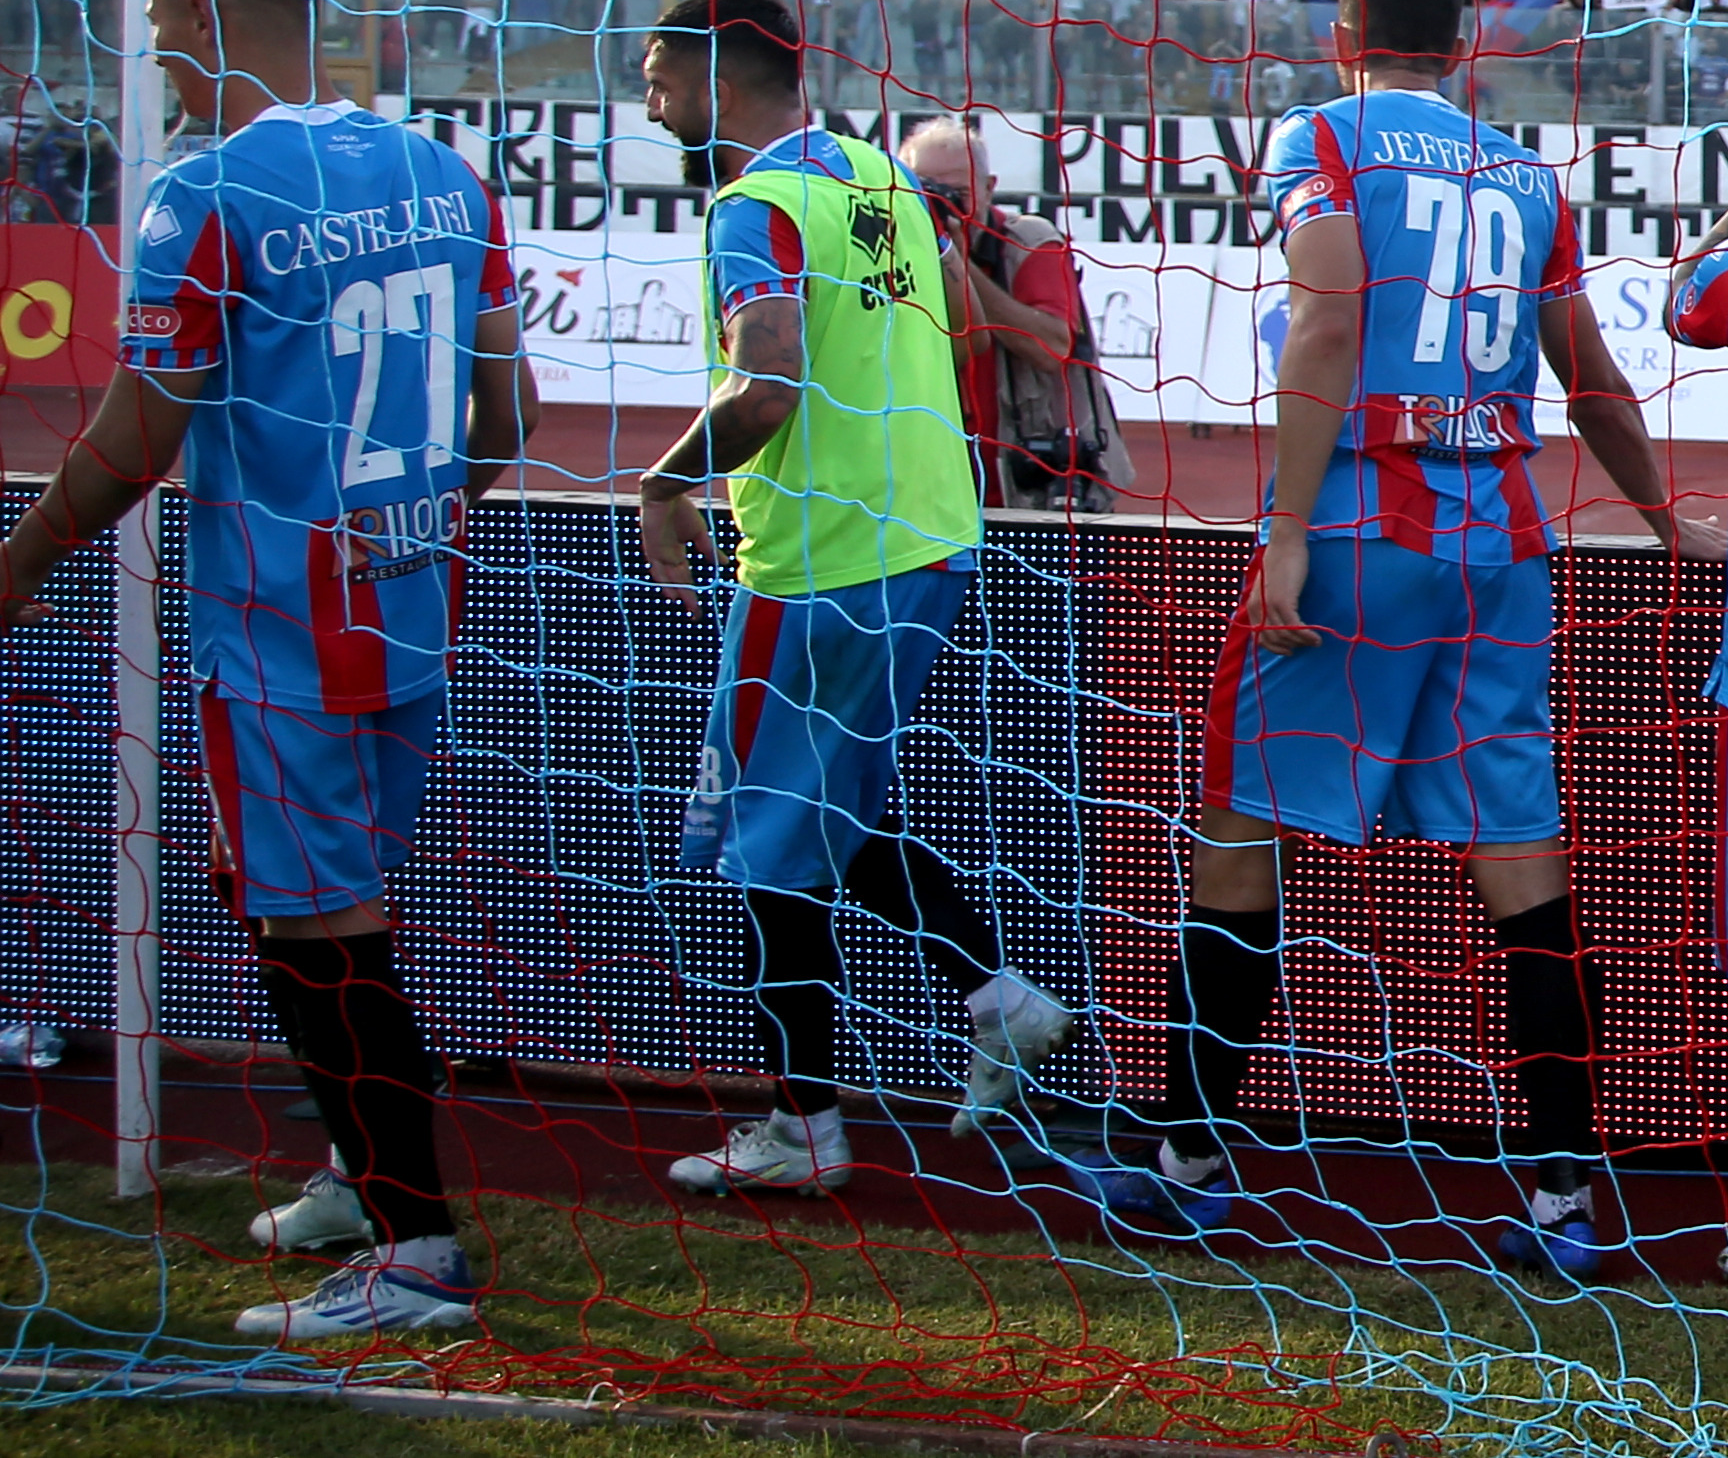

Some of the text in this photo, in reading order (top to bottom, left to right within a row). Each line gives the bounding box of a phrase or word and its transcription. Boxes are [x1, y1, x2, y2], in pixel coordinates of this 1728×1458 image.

[260, 190, 474, 276] CASTELLINI
[1374, 130, 1550, 206] JEFFERSON
[1406, 173, 1526, 373] 79
[332, 262, 455, 491] 27
